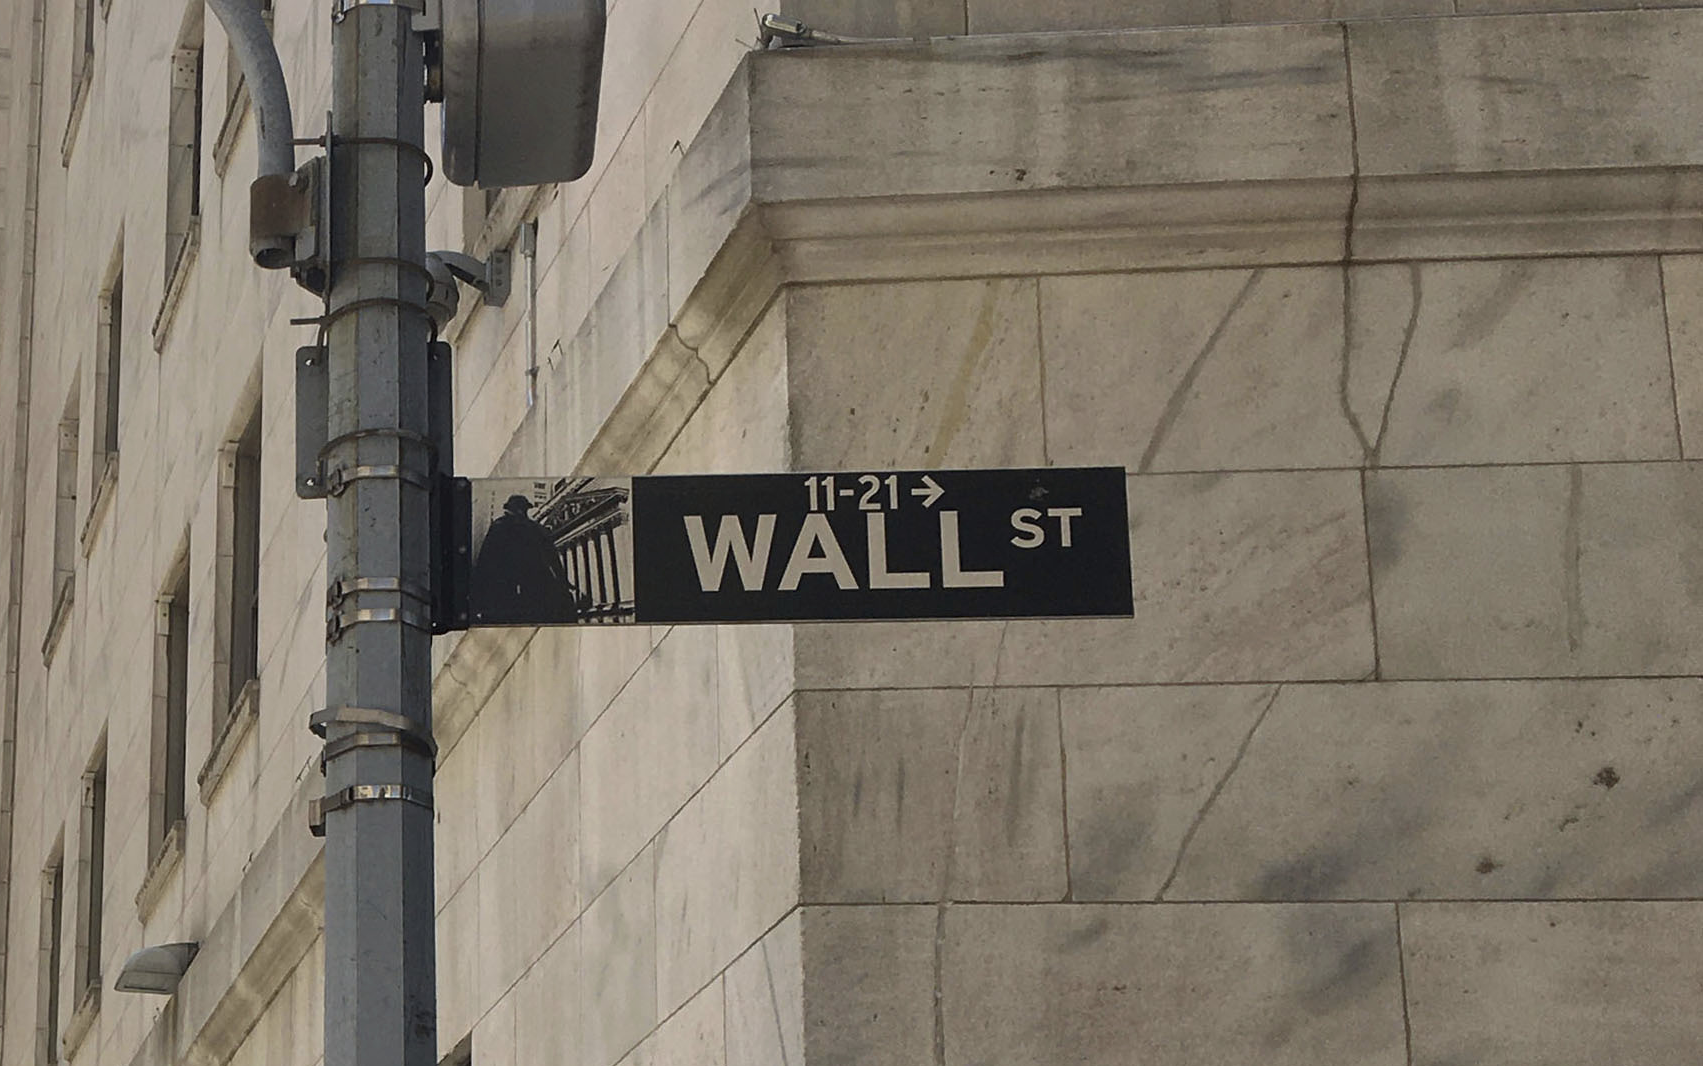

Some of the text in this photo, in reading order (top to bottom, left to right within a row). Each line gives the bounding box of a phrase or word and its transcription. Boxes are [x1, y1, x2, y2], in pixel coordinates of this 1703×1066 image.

[804, 475, 899, 511] 11-21
[683, 508, 1083, 591] WALL ST
